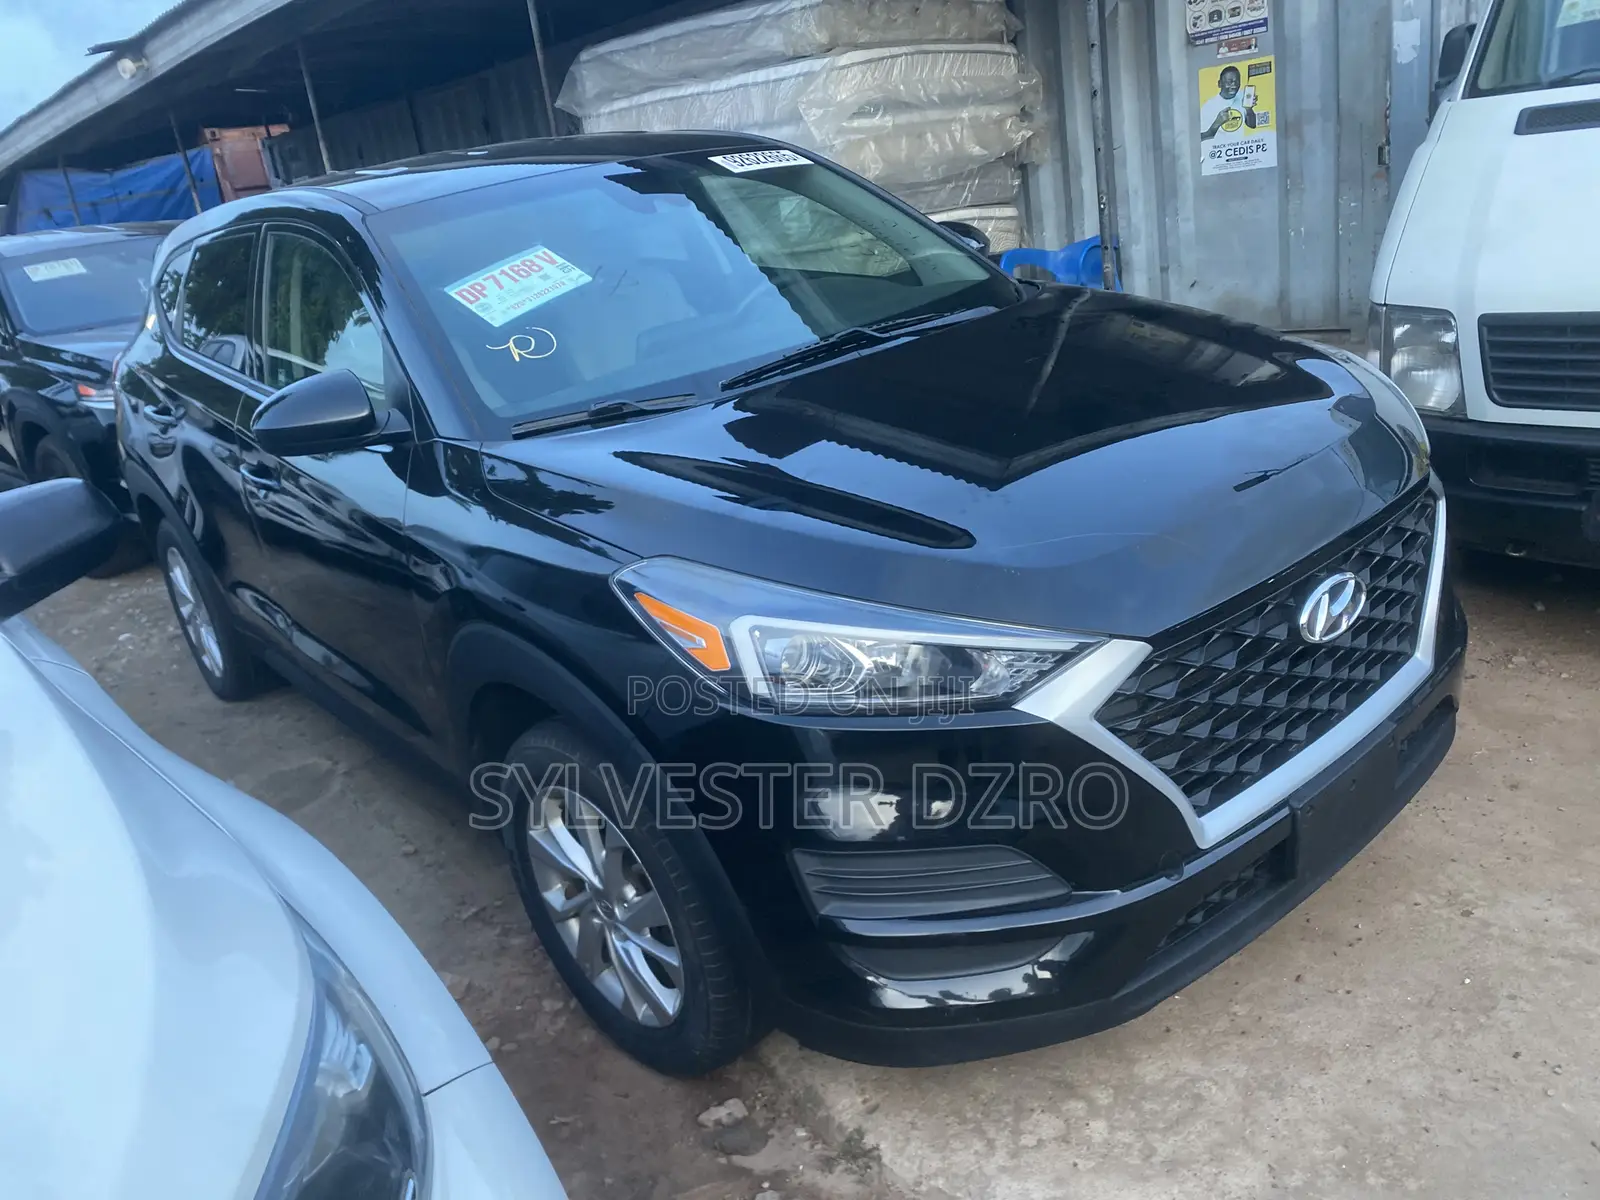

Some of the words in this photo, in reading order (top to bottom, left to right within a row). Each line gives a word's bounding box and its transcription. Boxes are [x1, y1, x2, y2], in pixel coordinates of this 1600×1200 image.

[1209, 150, 1222, 159] @2
[1225, 145, 1254, 157] CEDIS
[455, 281, 488, 305] DP
[483, 258, 545, 290] 7168
[534, 250, 559, 266] V
